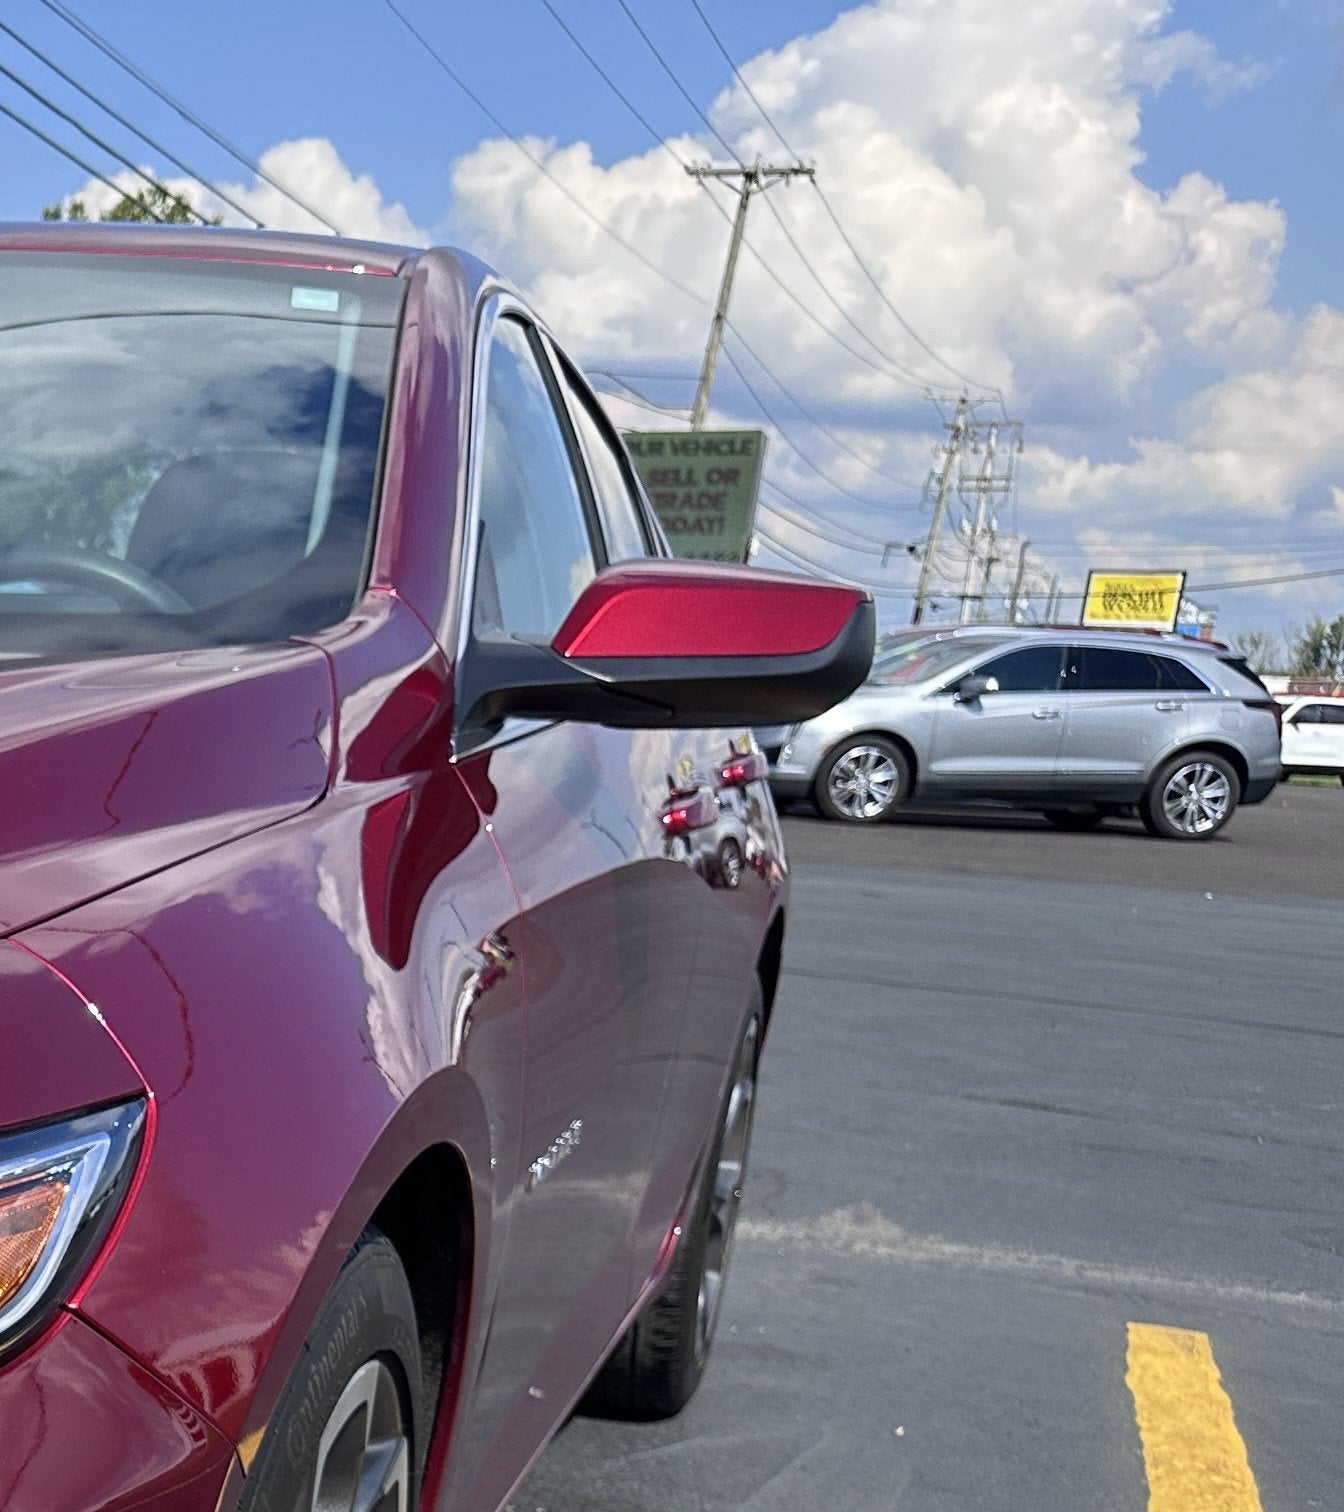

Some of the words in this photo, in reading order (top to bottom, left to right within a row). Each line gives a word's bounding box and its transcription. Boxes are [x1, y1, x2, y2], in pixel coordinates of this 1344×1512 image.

[671, 436, 754, 456] VEHICLE
[648, 467, 697, 487] SELL
[705, 467, 740, 486] OR
